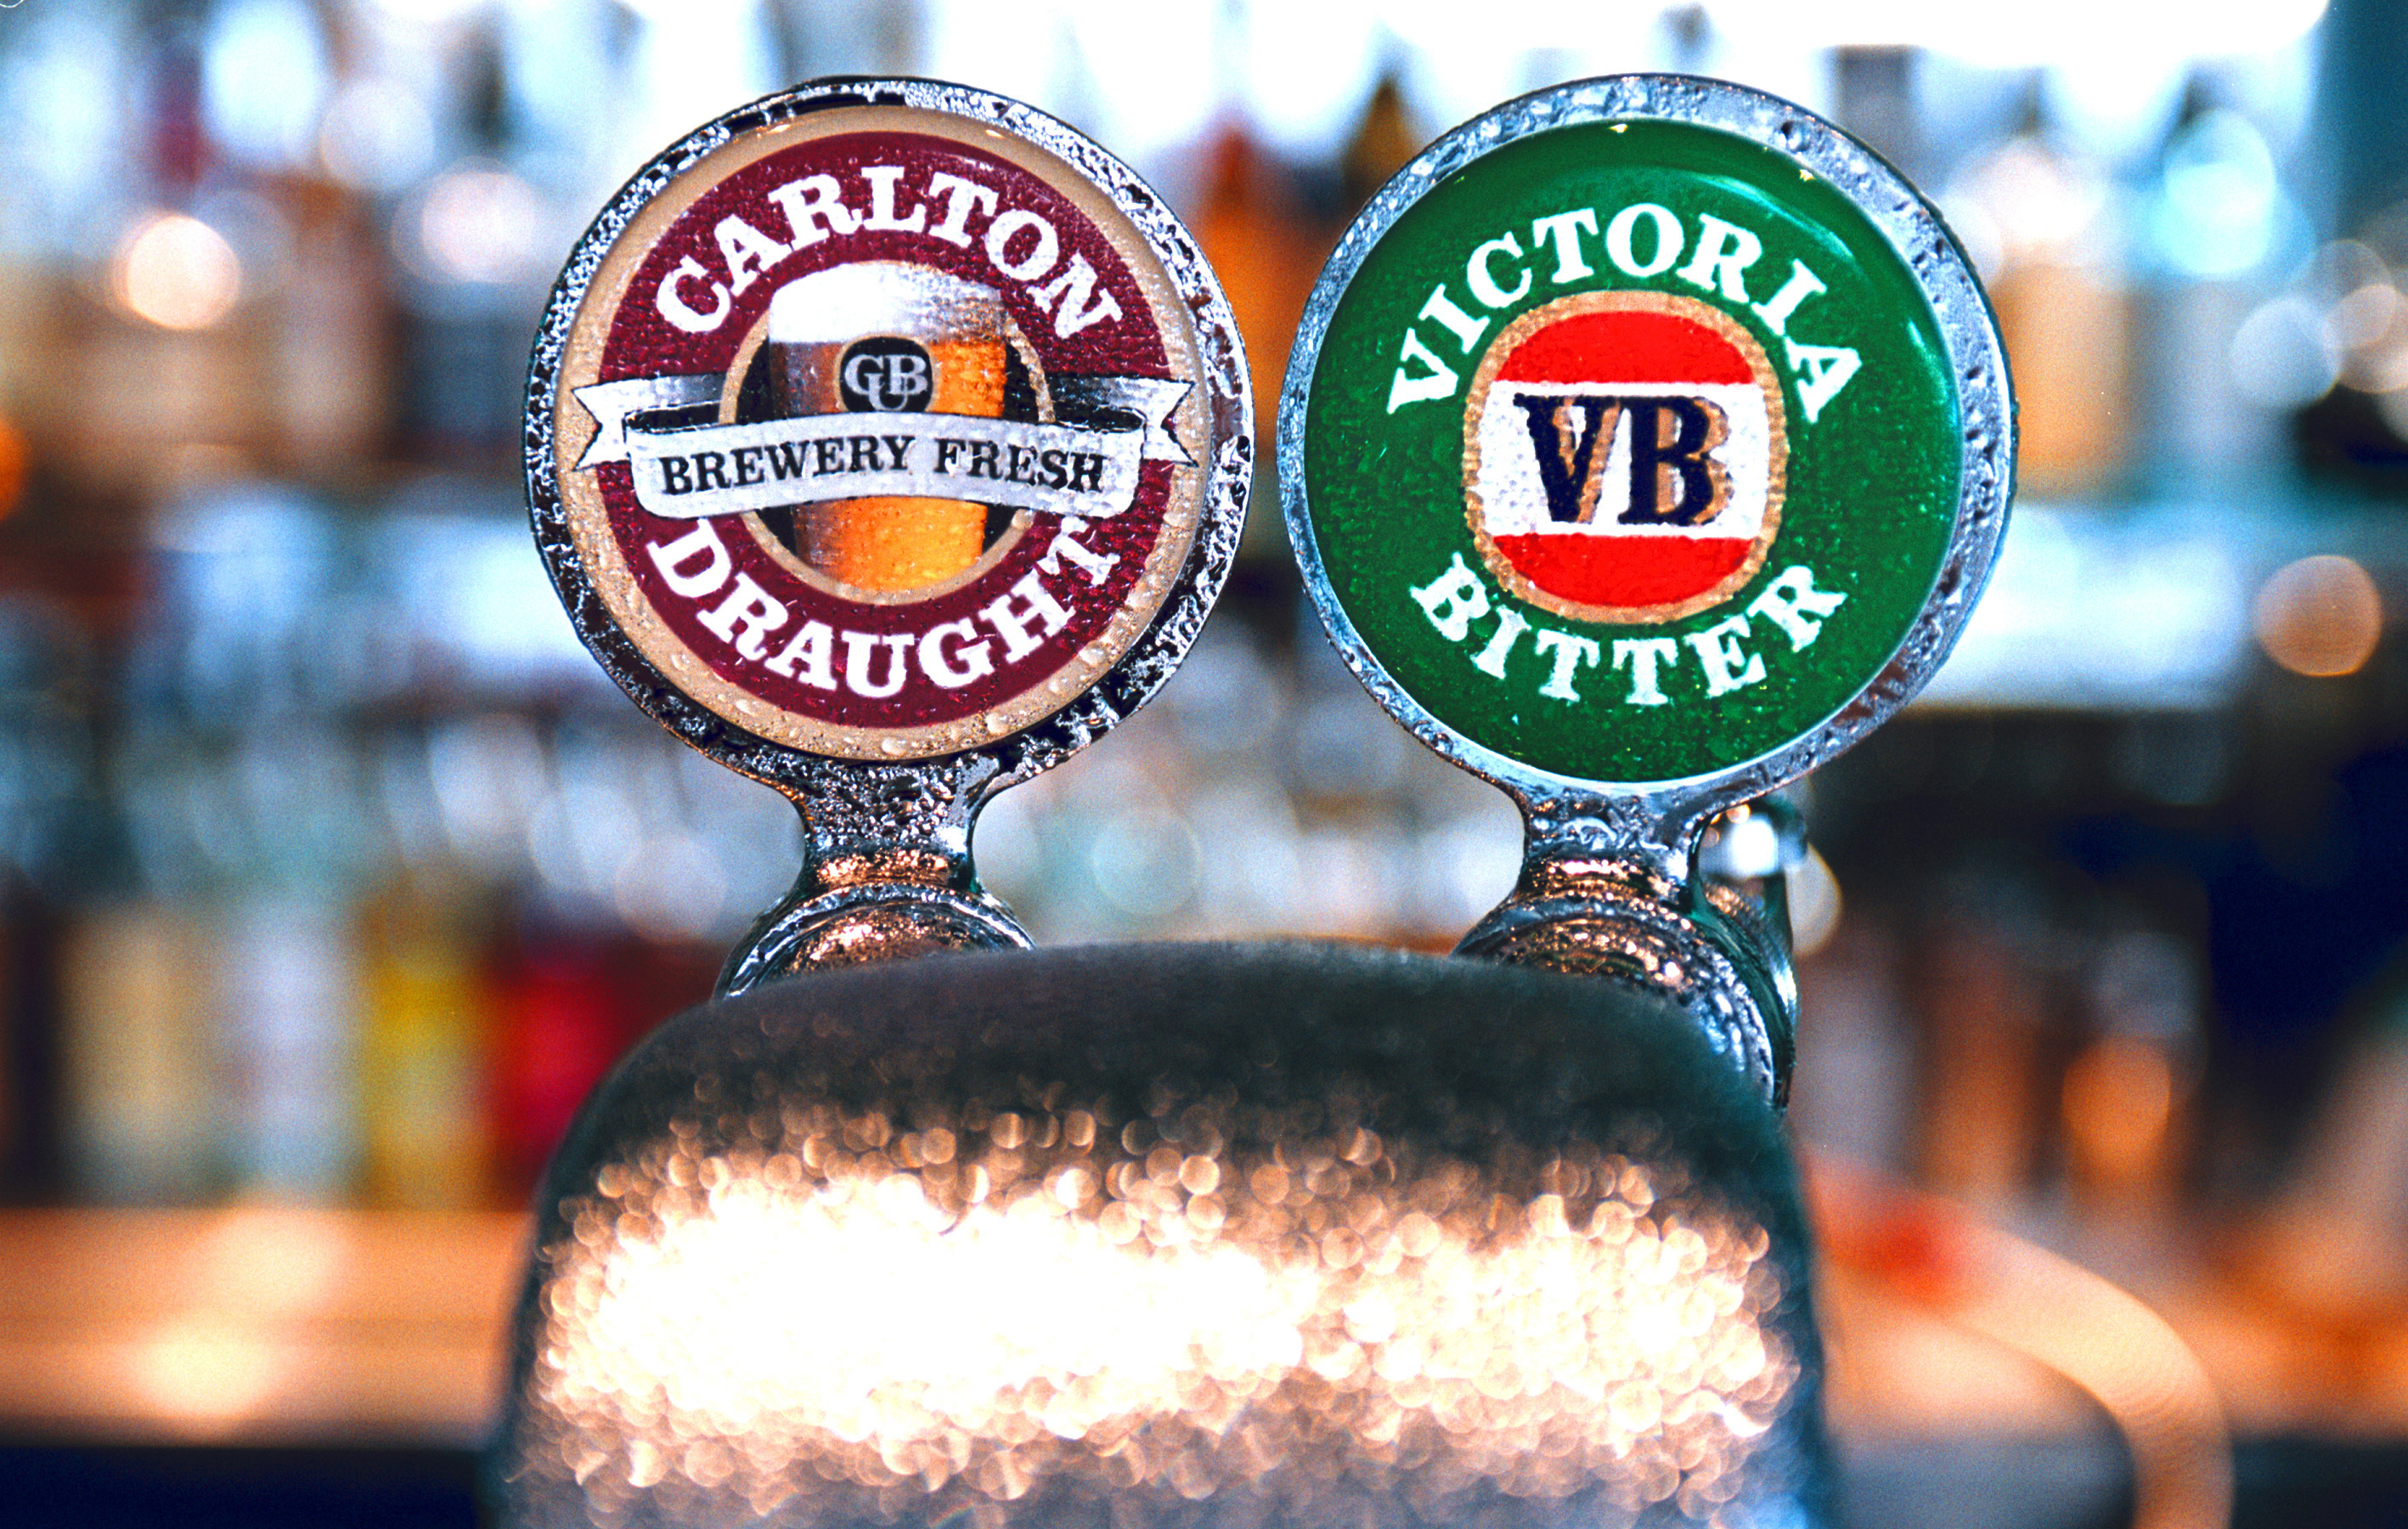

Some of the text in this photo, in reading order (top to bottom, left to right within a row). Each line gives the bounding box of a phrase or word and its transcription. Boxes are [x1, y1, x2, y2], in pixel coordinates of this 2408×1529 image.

[656, 167, 1123, 339] CARLTON
[1386, 203, 1862, 422] VICTORIA
[660, 435, 1106, 494] BREWERY FRESH
[1514, 393, 1734, 526] VB
[647, 516, 1120, 698] DRAUGHT
[1410, 552, 1847, 706] BITTER
